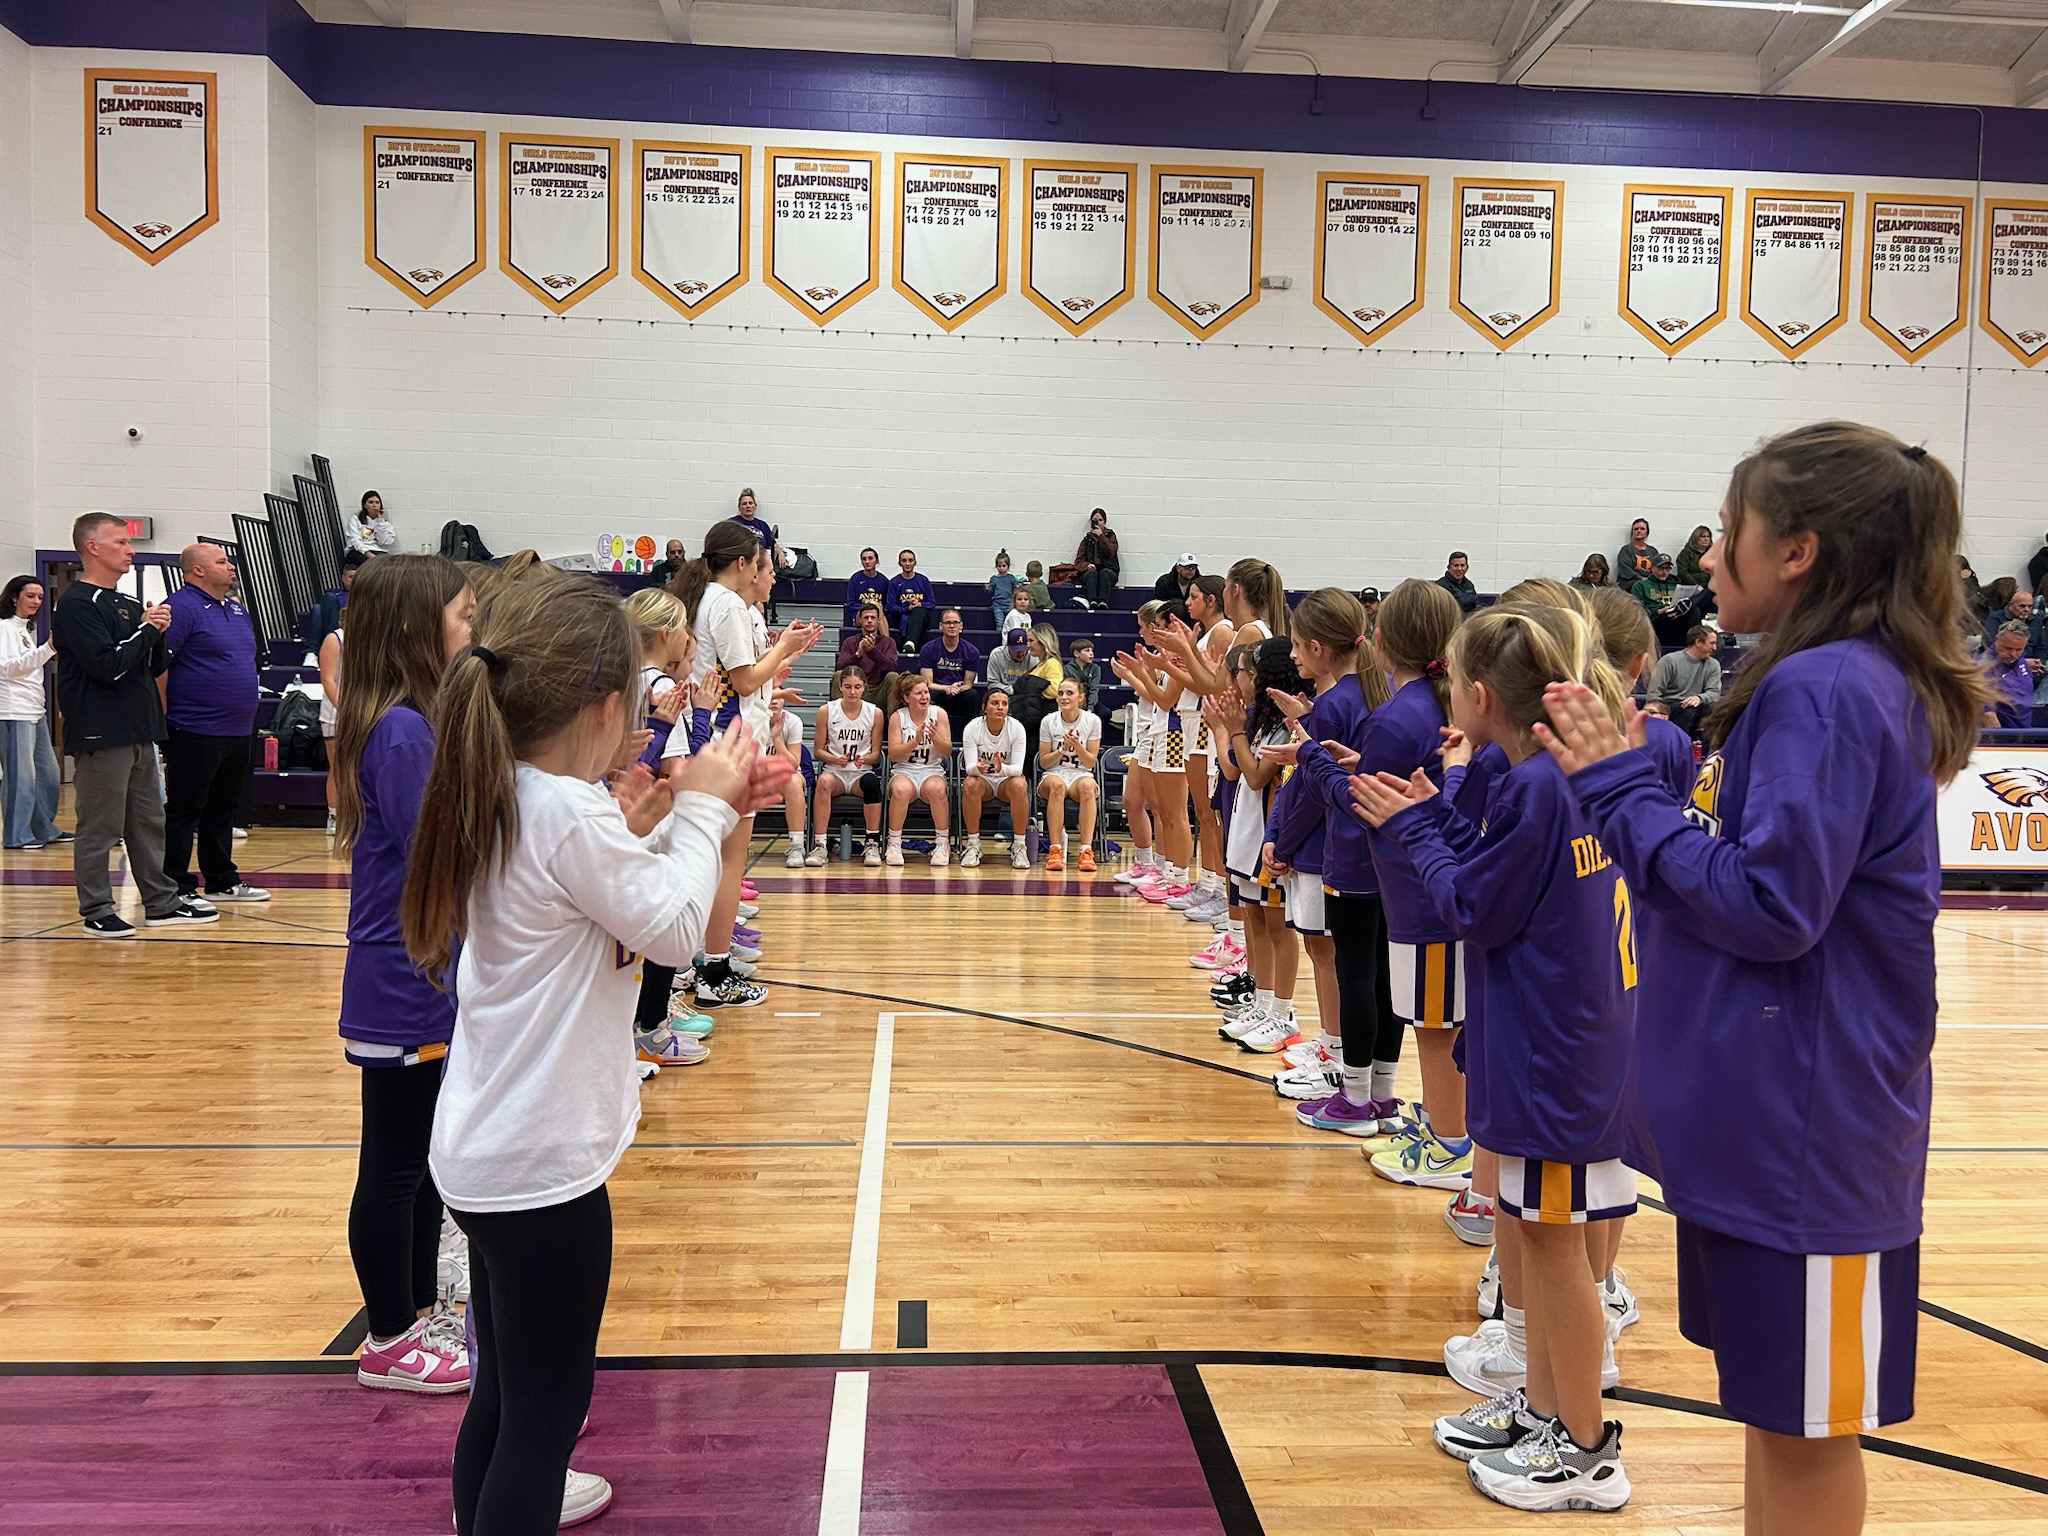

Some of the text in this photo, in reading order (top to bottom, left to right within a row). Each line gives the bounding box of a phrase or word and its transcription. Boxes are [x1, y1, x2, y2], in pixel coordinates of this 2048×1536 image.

[99, 98, 203, 117] CHAMPIONSHIPS
[119, 117, 182, 128] CONFERENCE
[98, 127, 111, 135] 21
[378, 154, 472, 172] CHAMPIONSHIPS
[513, 161, 607, 180] CHAMPIONSHIPS
[396, 171, 454, 182] CONFERENCE
[646, 167, 738, 186] CHAMPIONSHIPS
[531, 178, 588, 189] CONFERENCE
[777, 174, 868, 192] CHAMPIONSHIPS
[513, 187, 525, 195] 17
[529, 188, 542, 196] 18
[545, 188, 557, 197] 21
[560, 189, 573, 198] 22
[576, 190, 589, 198] 23
[663, 184, 720, 196] CONFERENCE
[906, 180, 997, 199] CHAMPIONSHIPS
[1035, 186, 1125, 204] CHAMPIONSHIPS
[646, 193, 658, 202] 15
[692, 195, 705, 204] 22
[707, 196, 721, 204] 23
[722, 196, 735, 204] 24
[794, 191, 850, 202] CONFERENCE
[1162, 191, 1250, 208] CHAMPIONSHIPS
[776, 200, 868, 211] 10 11 12 14 15 16
[924, 197, 979, 208] CONFERENCE
[1052, 203, 1107, 213] CONFERENCE
[1328, 198, 1416, 216] CHAMPIONSHIPS
[776, 209, 853, 221] 19 20 21 22 23
[906, 205, 997, 218] 71 72 75 77 00 12
[1034, 211, 1125, 223] 09 10 11 12 13 14
[1179, 208, 1233, 218] CONFERENCE
[1465, 204, 1551, 221] CHAMPIONSHIPS
[906, 215, 964, 226] 14 19 20 21
[1161, 216, 1174, 225] 09
[1177, 217, 1188, 225] 11
[1192, 218, 1204, 226] 14
[1345, 215, 1399, 225] CONFERENCE
[1634, 210, 1720, 227] CHAMPIONSHIPS
[1756, 214, 1841, 231] CHAMPIONSHIPS
[1034, 221, 1094, 231] 15 19 21 22
[1327, 223, 1415, 234] 07 08 09 10 14 22
[1481, 220, 1534, 230] CONFERENCE
[1876, 219, 1960, 236] CHAMPIONSHIPS
[1463, 229, 1551, 239] 02 03 04 08 09 10
[1650, 226, 1703, 236] CONFERENCE
[1772, 230, 1824, 241] CONFERENCE
[1463, 238, 1491, 247] 21 22
[1633, 235, 1719, 246] 59 77 78 80 96 04
[1755, 239, 1840, 250] 75 77 84 86 11 12
[1892, 235, 1943, 245] CONFERENCE
[1632, 244, 1719, 255] 08 10 11 12 13 16
[1754, 248, 1766, 257] 15
[1875, 244, 1959, 255] 78 85 88 89 90 97
[1993, 248, 2005, 256] 73
[2007, 249, 2019, 257] 74
[1632, 254, 1719, 265] 17 18 19 20 21 22
[1631, 263, 1643, 272] 23
[598, 533, 624, 559] GO
[838, 729, 865, 741] AVON
[842, 744, 857, 762] 10
[908, 749, 930, 764] 24
[982, 752, 1007, 760] AVN
[1971, 812, 2048, 851] AVO
[1570, 834, 1612, 879] DIE
[1614, 876, 1638, 991] 2
